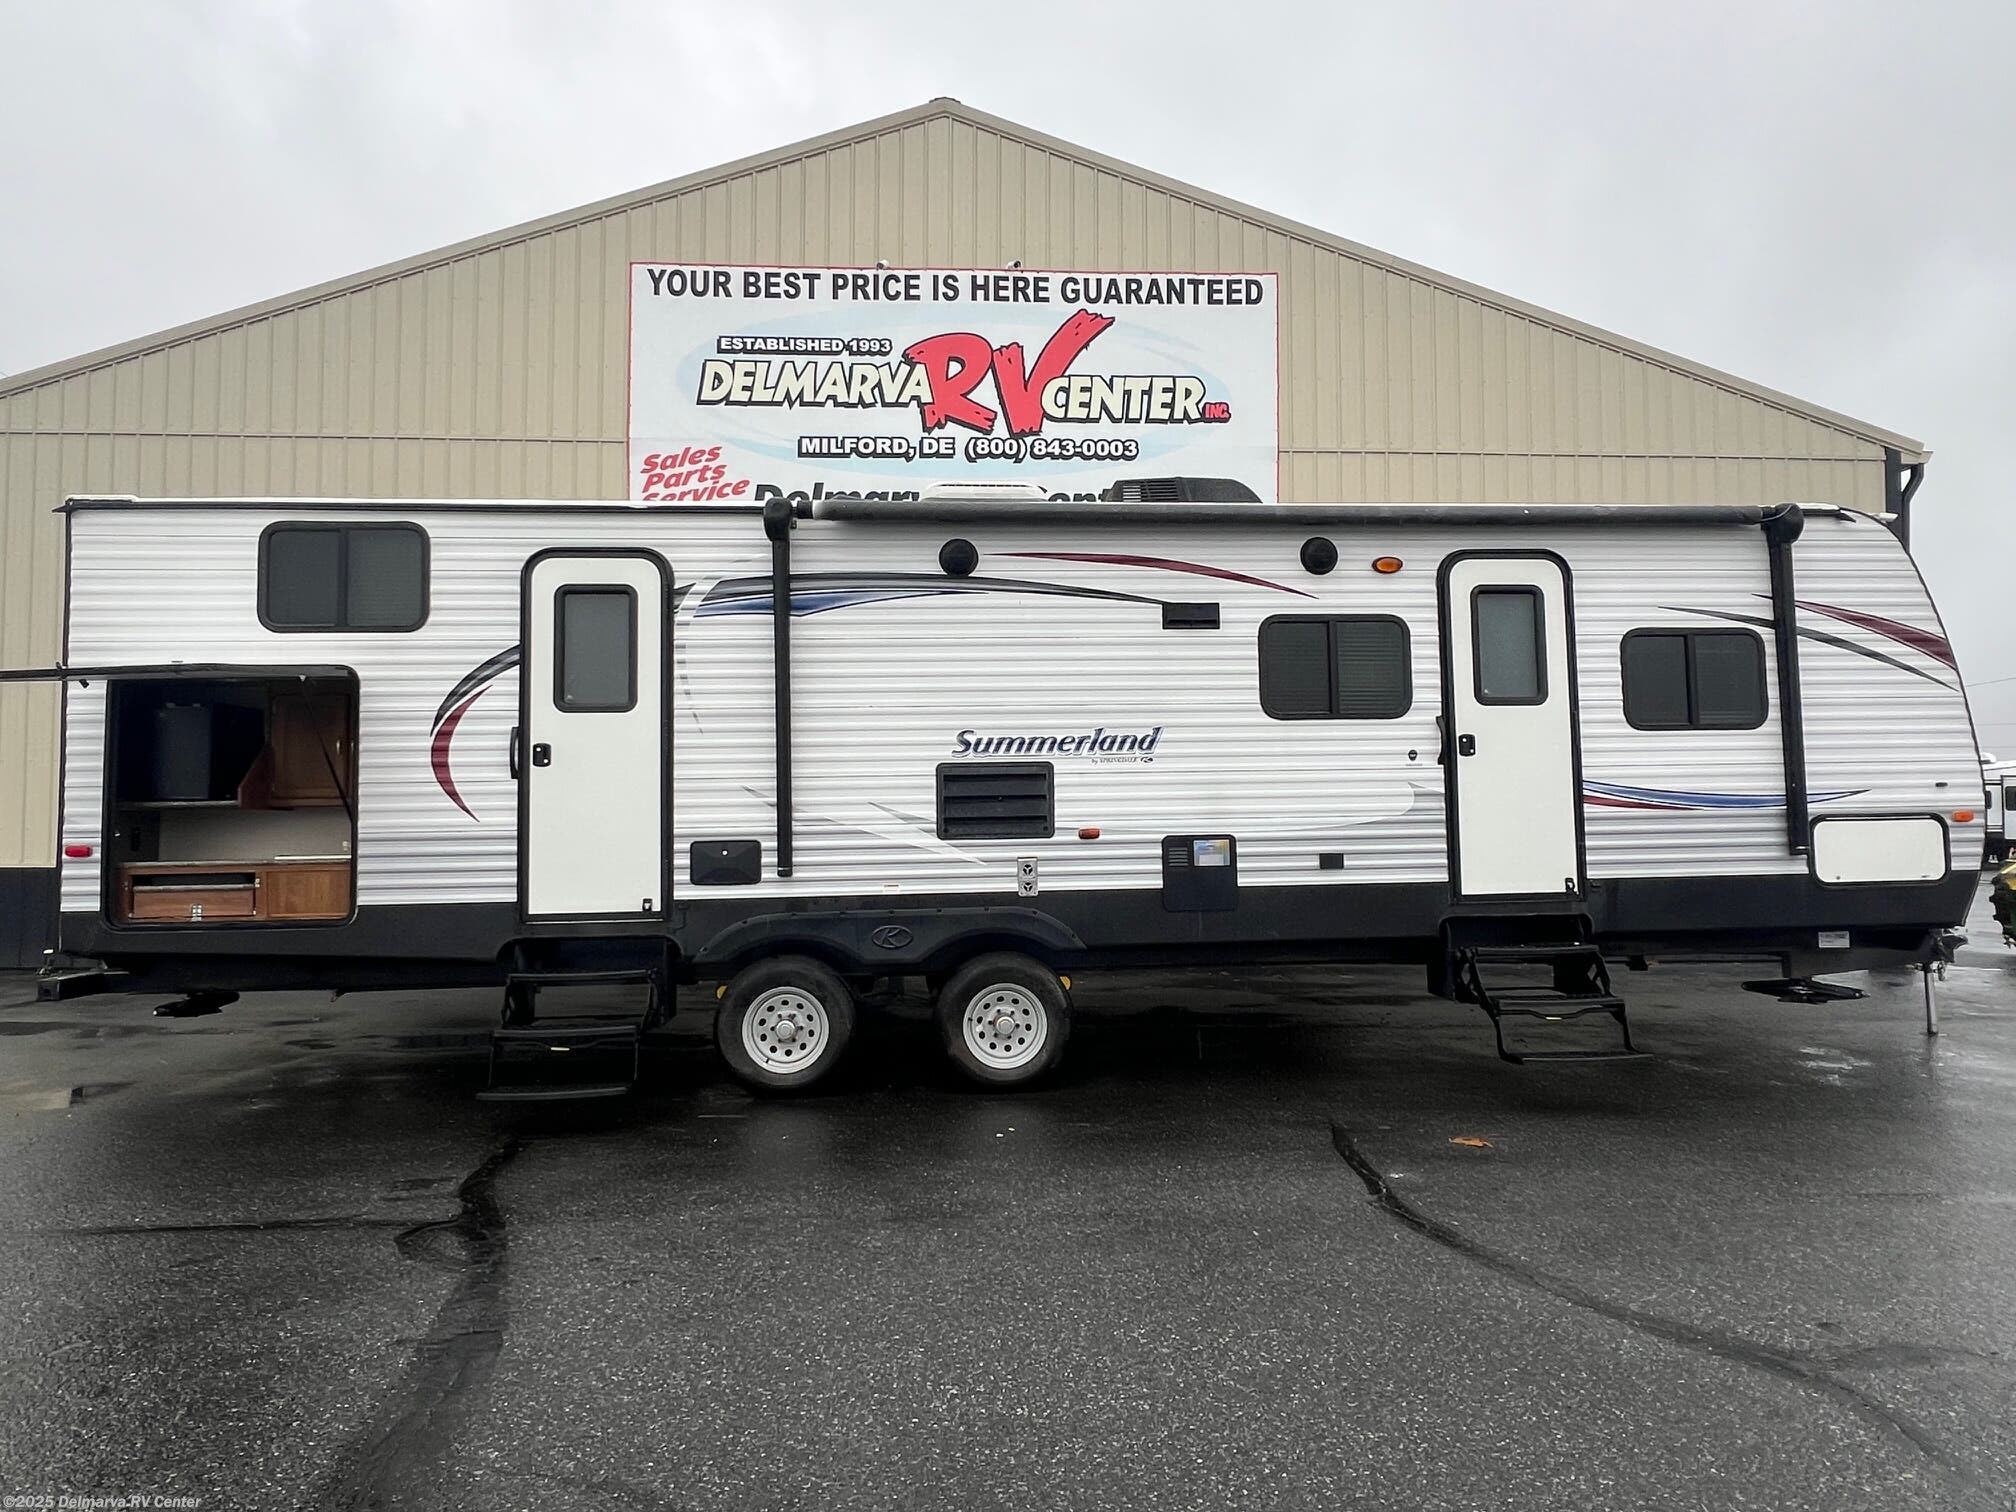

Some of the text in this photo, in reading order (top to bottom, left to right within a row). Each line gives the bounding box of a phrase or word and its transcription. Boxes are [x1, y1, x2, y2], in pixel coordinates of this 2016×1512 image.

[647, 268, 1264, 305] YOUR BEST PRICE IS HERE GUARANTEED
[718, 336, 893, 355] ESTABLISHED 1993
[697, 359, 935, 409] DELMARVA
[902, 308, 1116, 437] RV
[1040, 375, 1206, 424] CENTER
[640, 446, 723, 474] Sales
[798, 437, 1140, 463] MILFORD, DE (800) 843-0003
[642, 464, 728, 493] Parts
[951, 727, 1163, 757] Summerland
